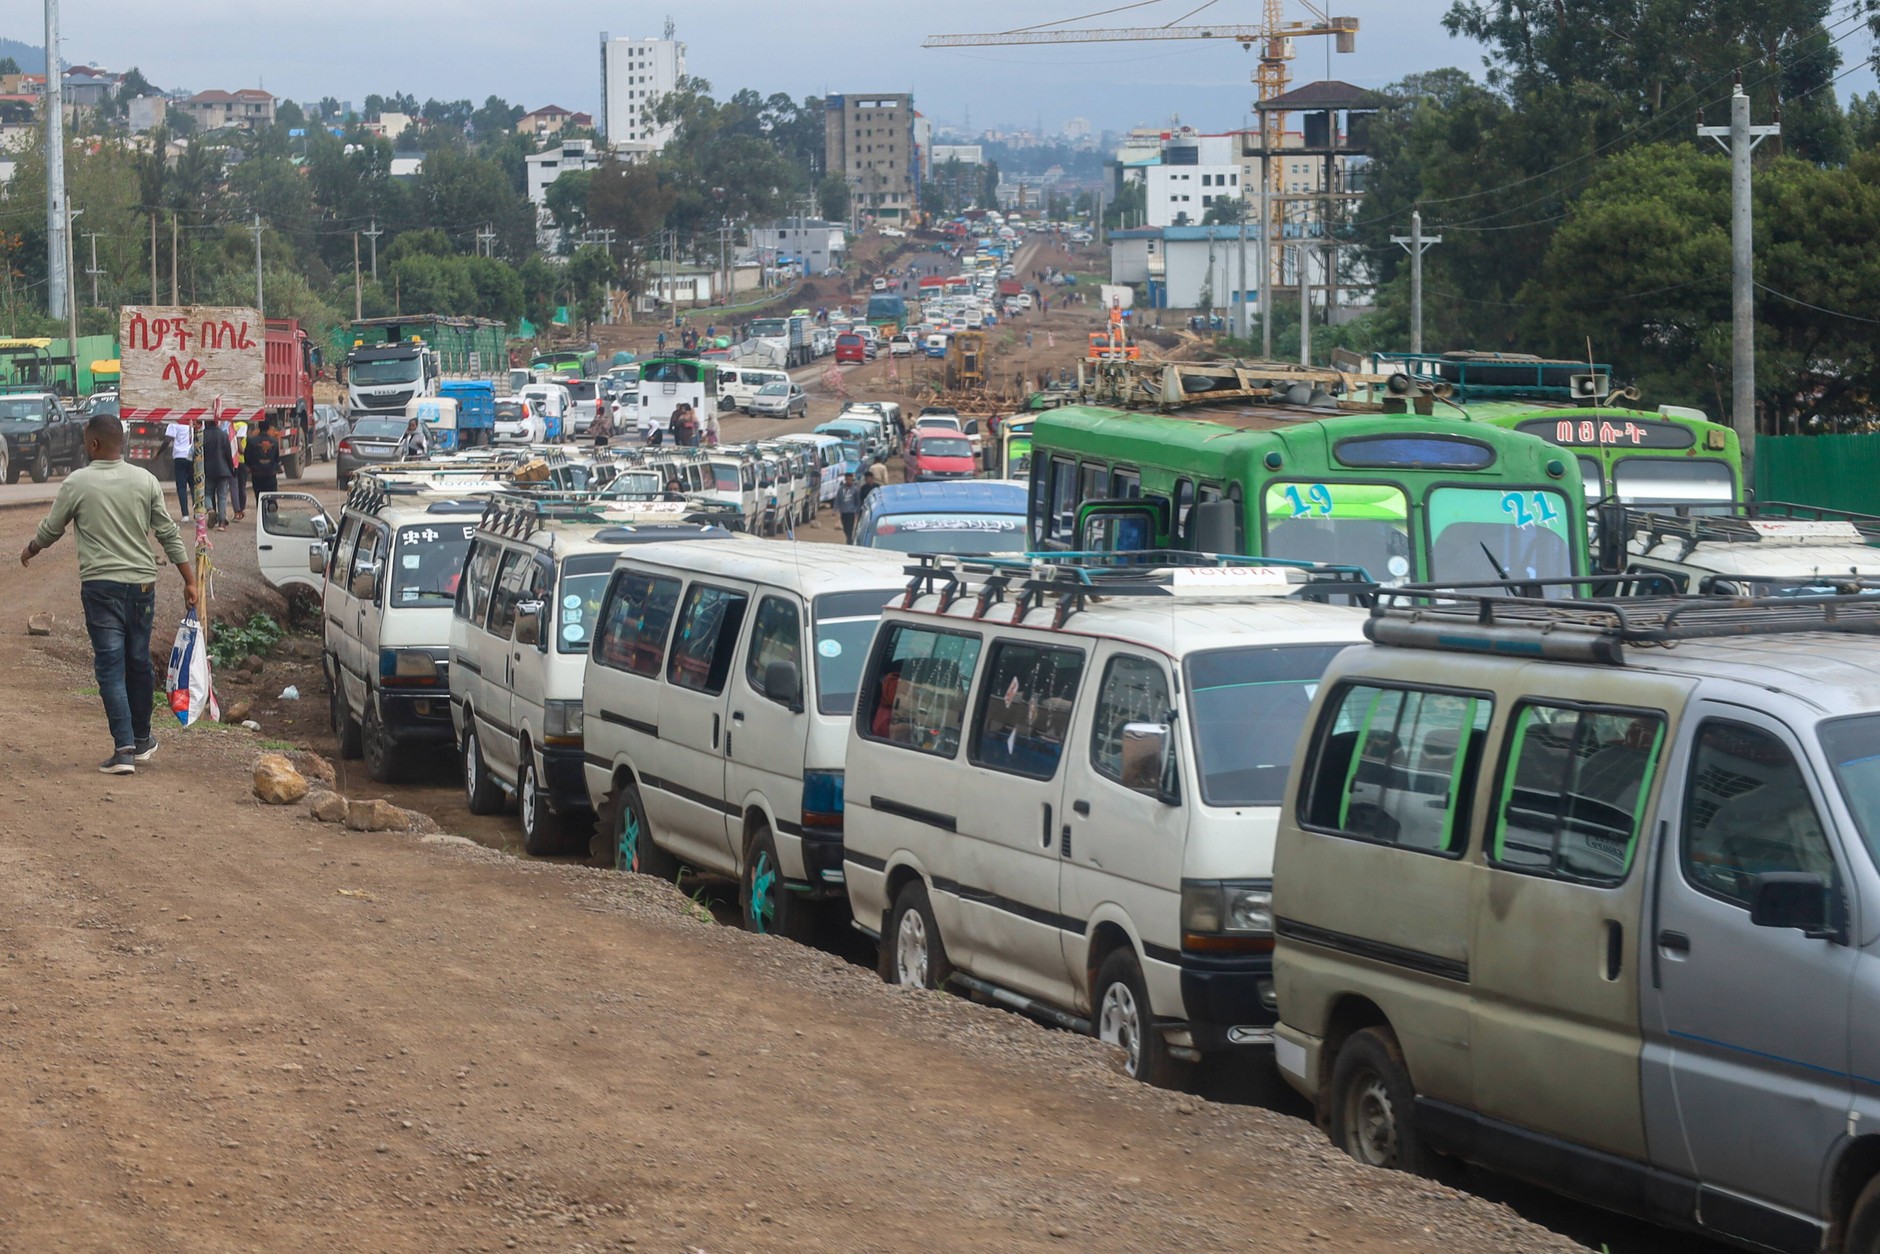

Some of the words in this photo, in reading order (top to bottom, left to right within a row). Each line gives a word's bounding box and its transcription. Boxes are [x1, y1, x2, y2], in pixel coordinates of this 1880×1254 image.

[129, 312, 193, 351] ሰዎች
[1284, 483, 1334, 519] 19
[1501, 490, 1559, 530] 21
[1186, 567, 1276, 576] TOYOTA
